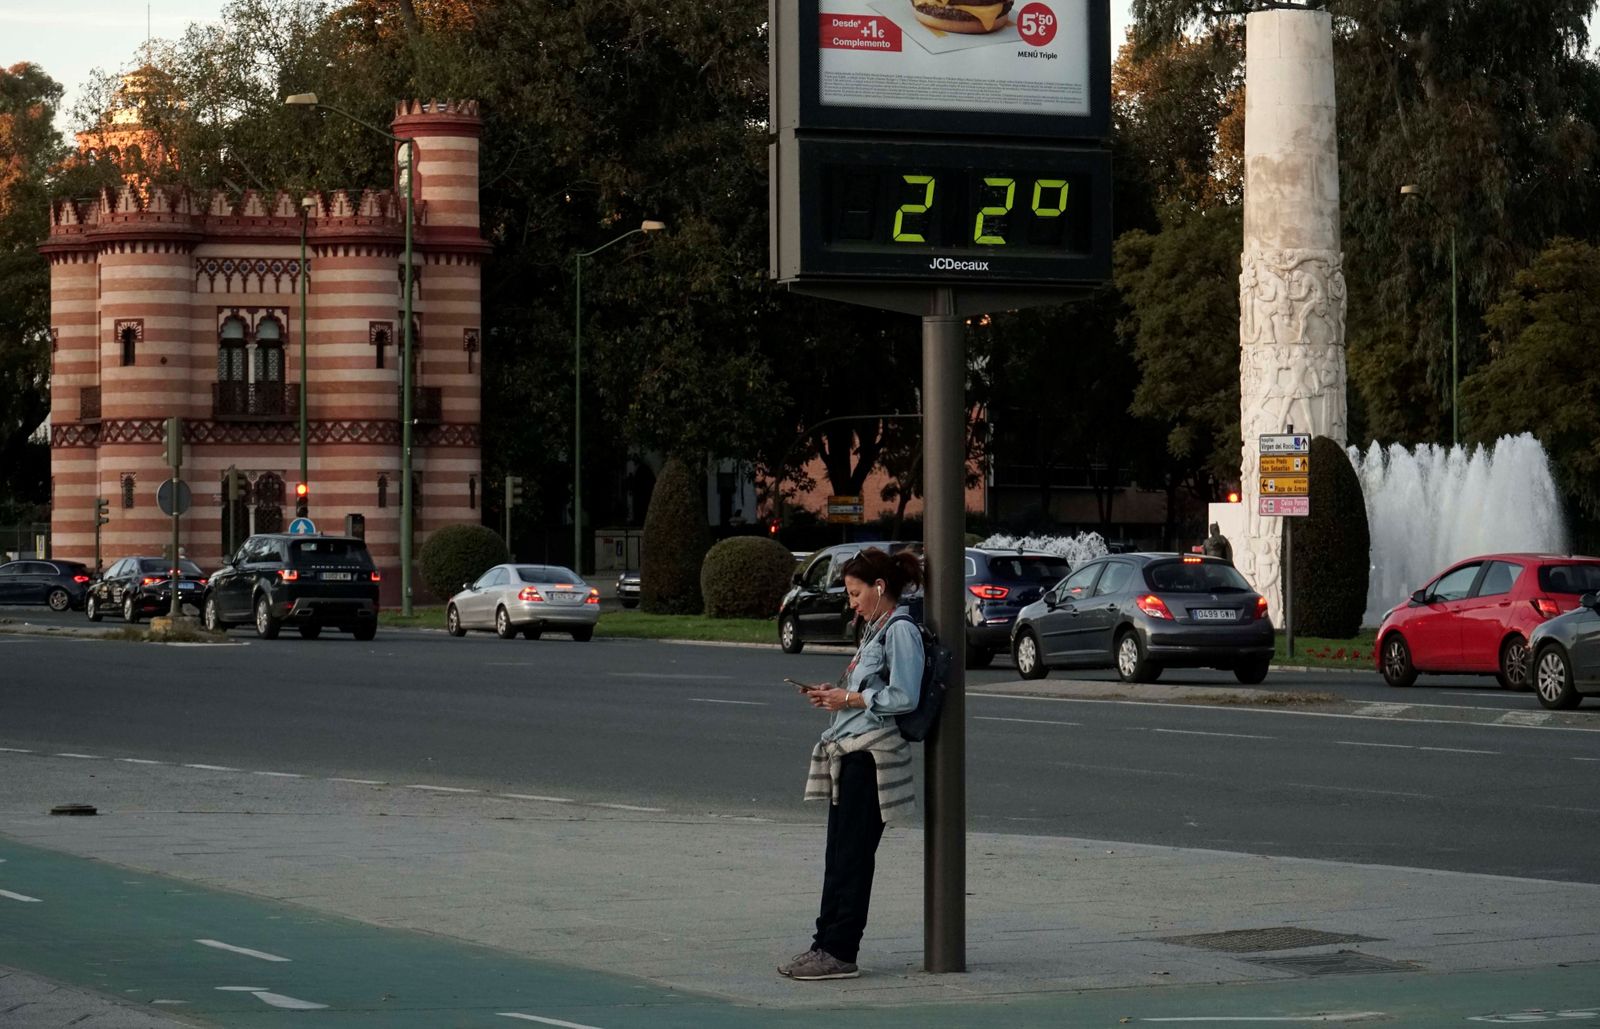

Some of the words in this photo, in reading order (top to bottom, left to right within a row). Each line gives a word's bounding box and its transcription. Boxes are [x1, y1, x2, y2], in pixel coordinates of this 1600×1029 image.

[832, 37, 891, 48] Complemento
[1039, 52, 1058, 60] Triple
[929, 258, 989, 271] JCDecaux
